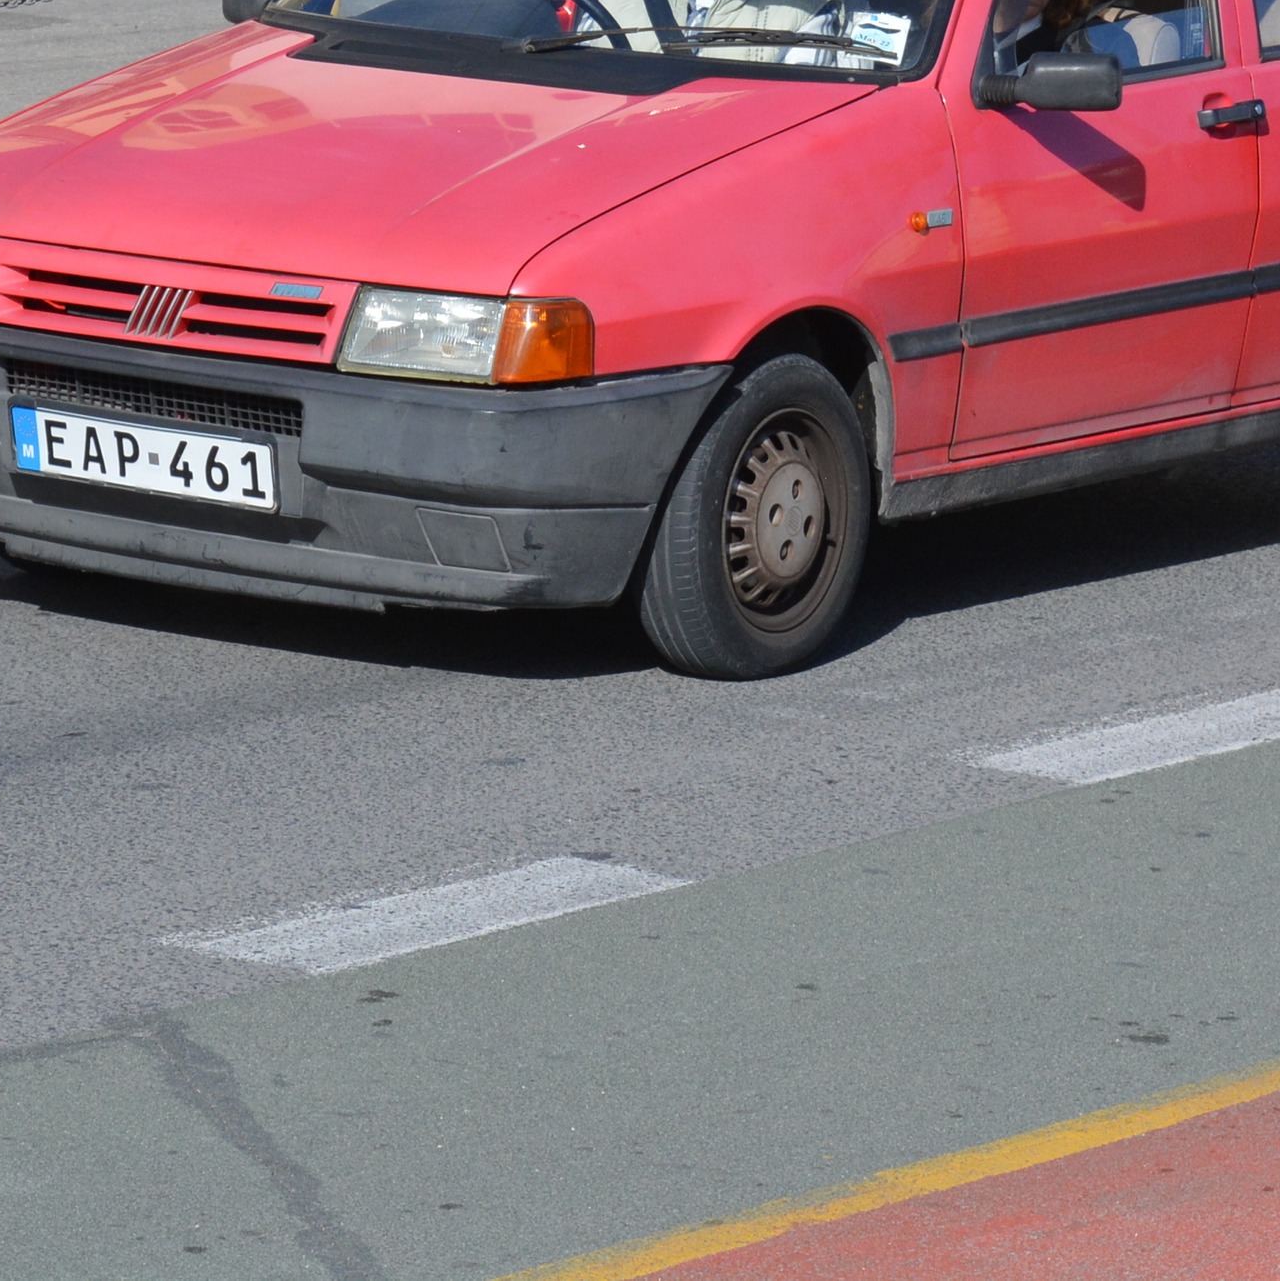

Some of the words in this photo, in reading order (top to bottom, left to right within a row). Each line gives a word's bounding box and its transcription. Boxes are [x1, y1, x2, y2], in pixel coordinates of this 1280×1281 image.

[22, 443, 35, 458] M
[44, 419, 140, 477] EAP
[169, 440, 267, 500] 461
